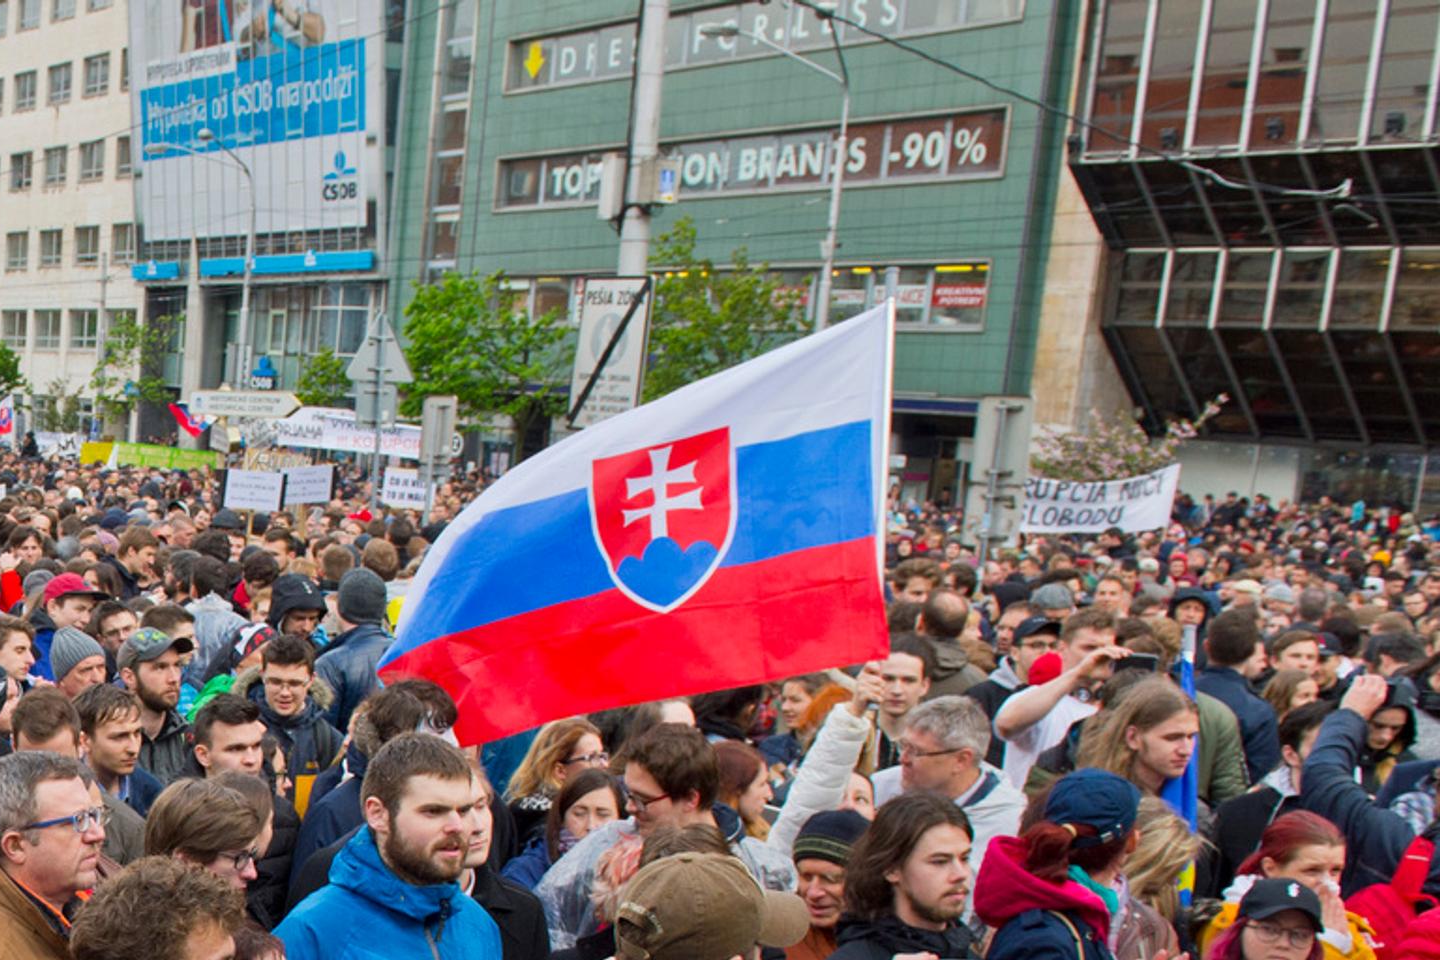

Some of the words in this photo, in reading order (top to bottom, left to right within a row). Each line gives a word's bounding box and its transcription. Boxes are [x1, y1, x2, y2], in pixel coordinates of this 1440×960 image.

[560, 34, 636, 75] DRE
[211, 89, 228, 119] od
[232, 77, 273, 116] ČSOB
[552, 161, 602, 196] TOP
[738, 136, 867, 184] BRANDS
[587, 286, 613, 304] PEŠIA
[616, 287, 644, 306] ZÓN
[1023, 477, 1108, 502] RUPCIA
